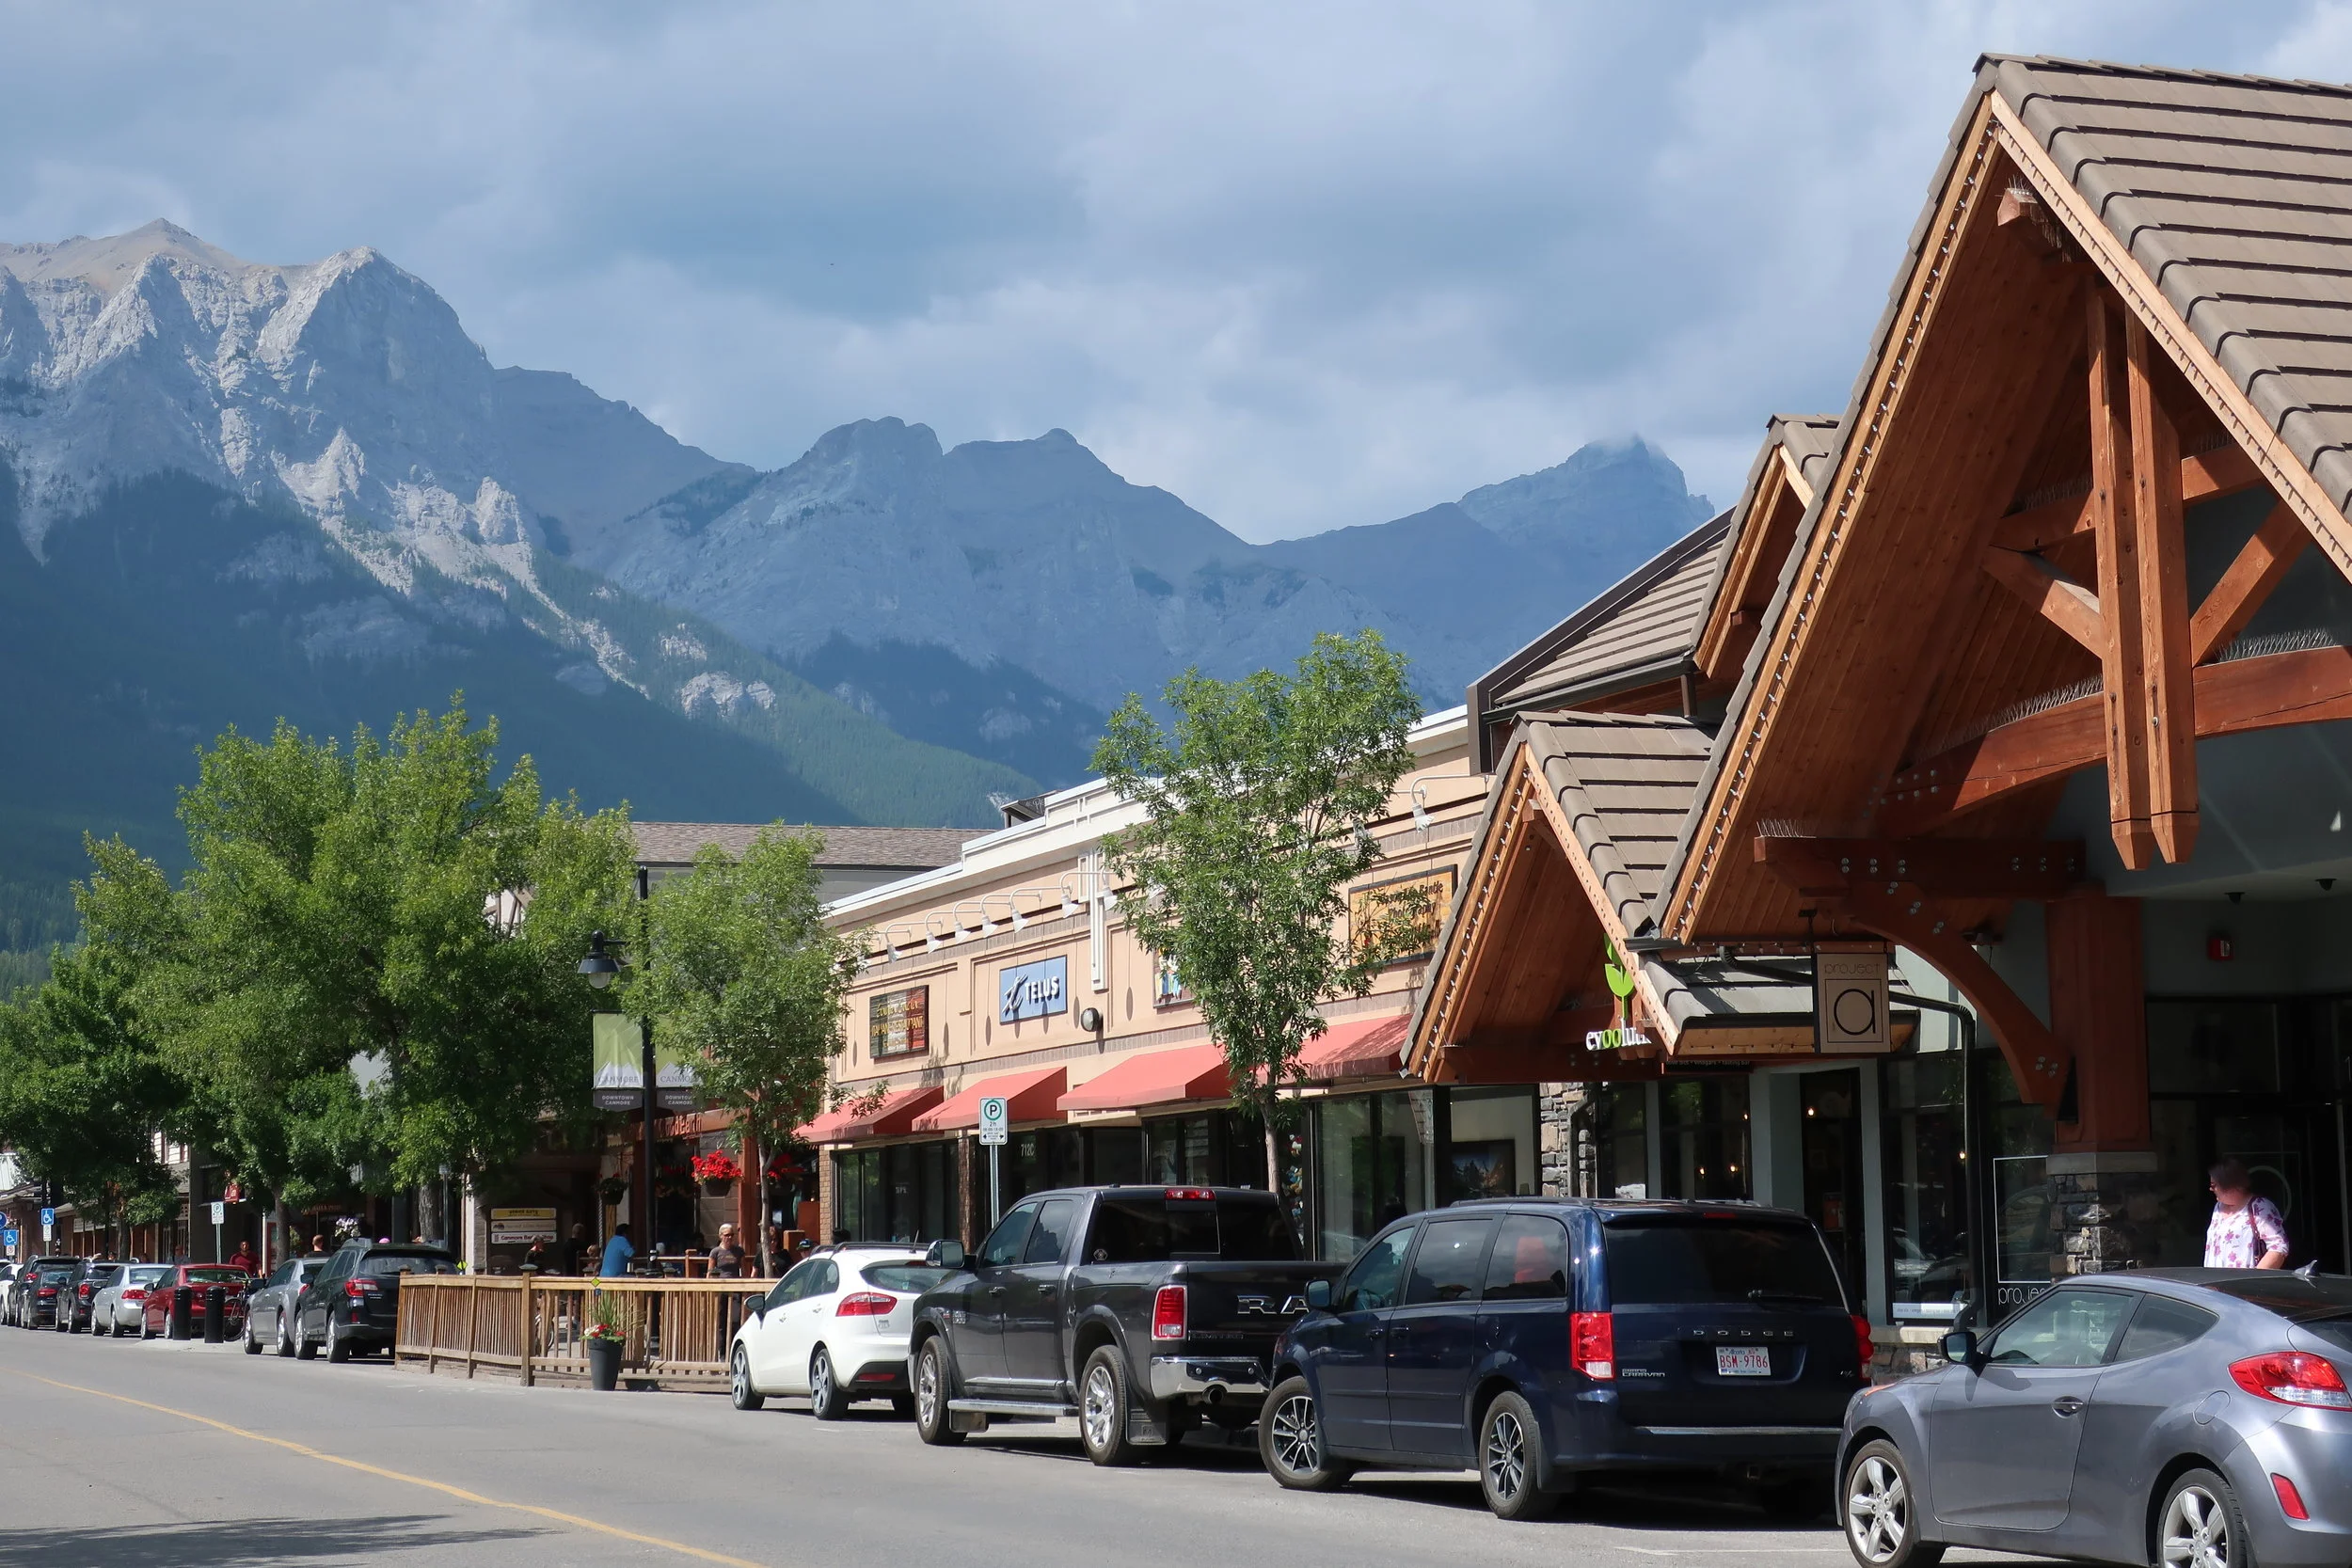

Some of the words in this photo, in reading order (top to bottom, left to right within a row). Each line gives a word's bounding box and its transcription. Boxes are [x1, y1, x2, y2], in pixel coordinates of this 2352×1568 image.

[1025, 976, 1059, 1002] TELUS
[990, 1104, 997, 1117] P
[1237, 1295, 1310, 1314] RA
[1720, 1354, 1769, 1368] BSM-9786
